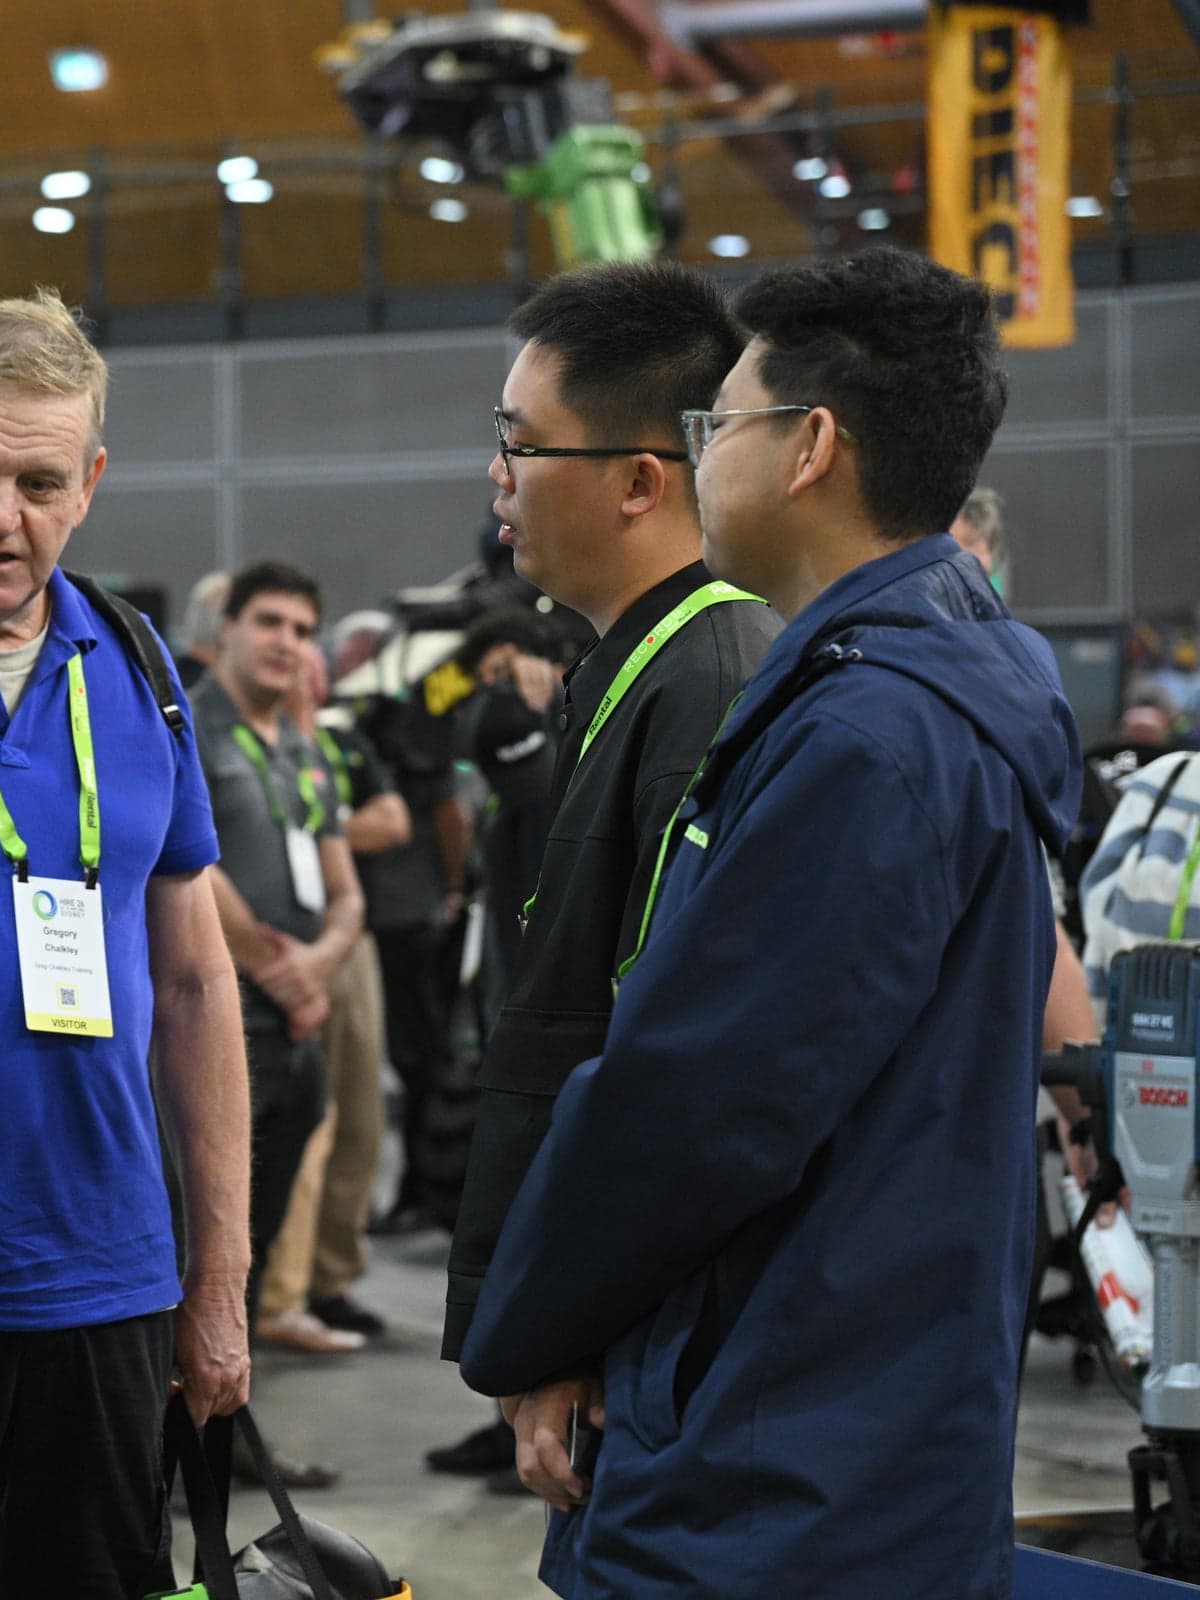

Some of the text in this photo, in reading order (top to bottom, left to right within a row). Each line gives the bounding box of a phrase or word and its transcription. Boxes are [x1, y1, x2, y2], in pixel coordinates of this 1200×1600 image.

[588, 696, 613, 735] Rental
[87, 792, 96, 829] Rental
[43, 926, 77, 940] Gregory
[51, 1018, 87, 1030] VISITOR
[1139, 1086, 1188, 1107] BOSCH
